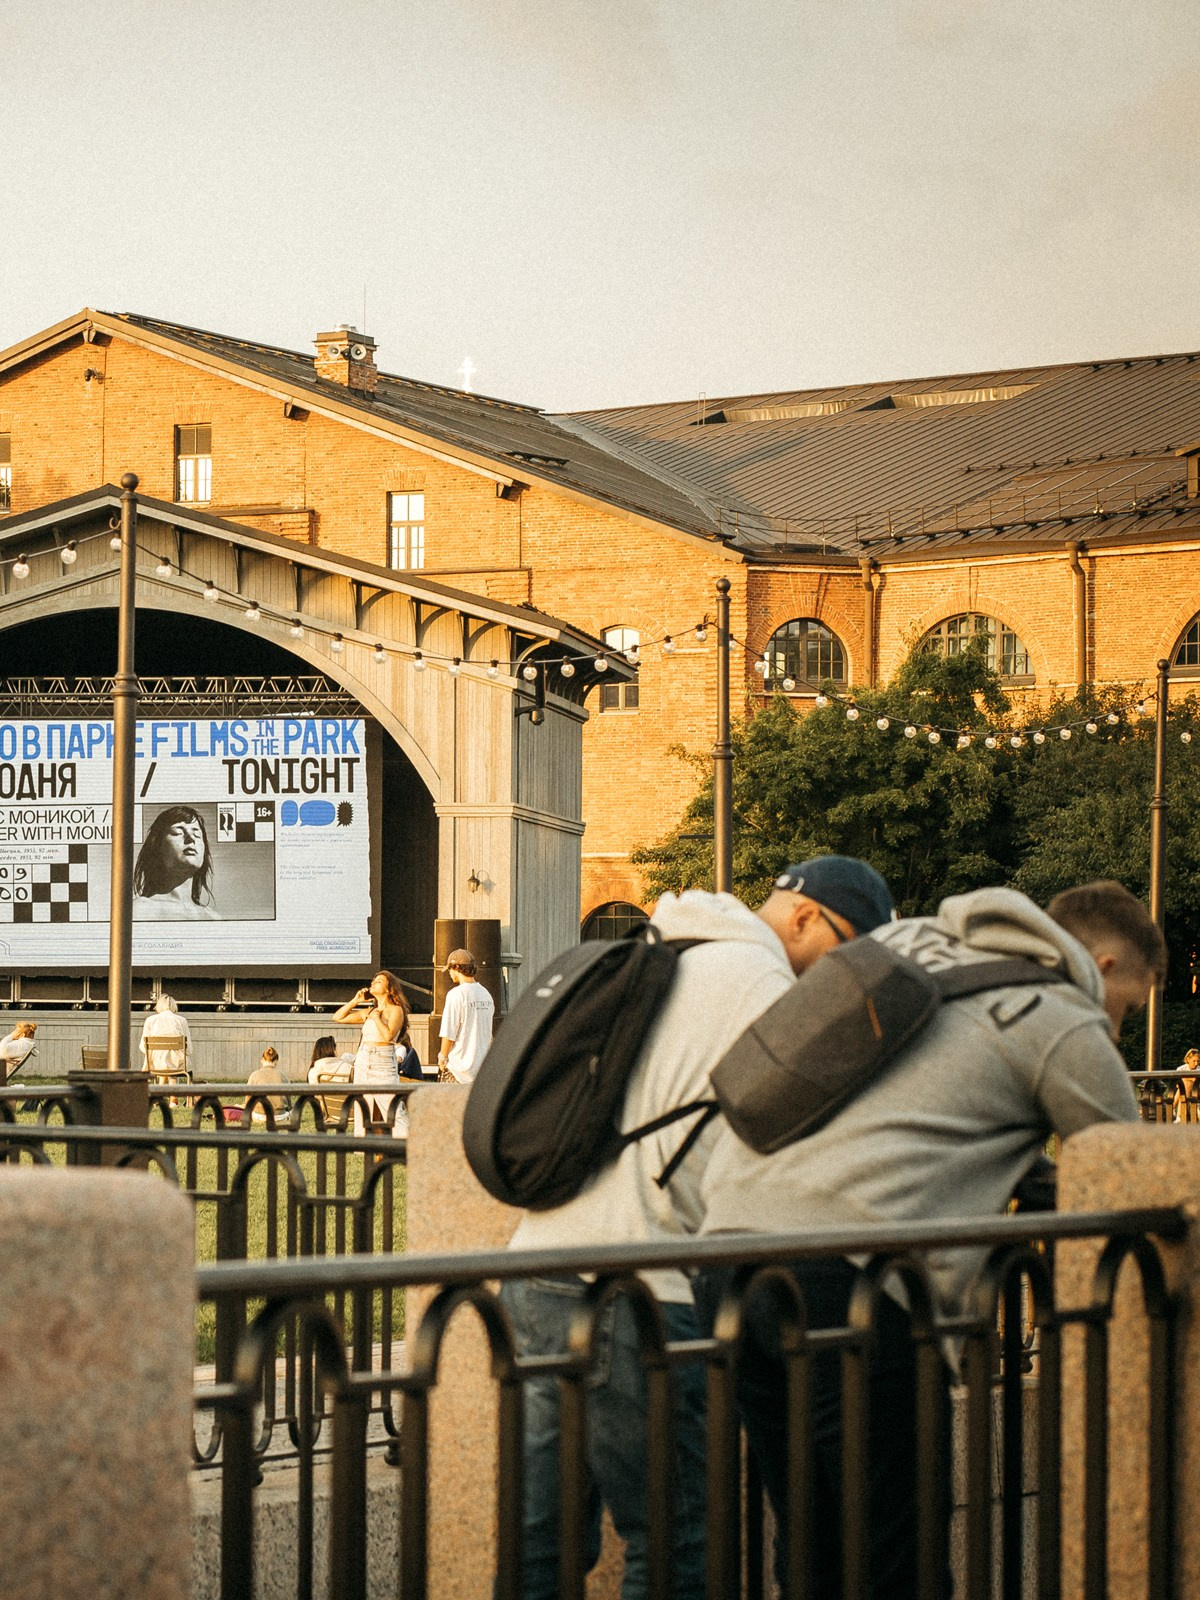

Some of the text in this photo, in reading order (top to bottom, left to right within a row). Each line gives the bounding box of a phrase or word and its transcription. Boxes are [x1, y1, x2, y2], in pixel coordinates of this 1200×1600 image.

[22, 725, 41, 760] В
[151, 719, 360, 757] FILMS IN THE PARK
[221, 757, 360, 795] TONIGHT
[9, 806, 95, 825] МОНИКОЙ
[256, 807, 273, 818] 16+
[22, 826, 62, 841] WITH
[66, 825, 113, 840] MONI
